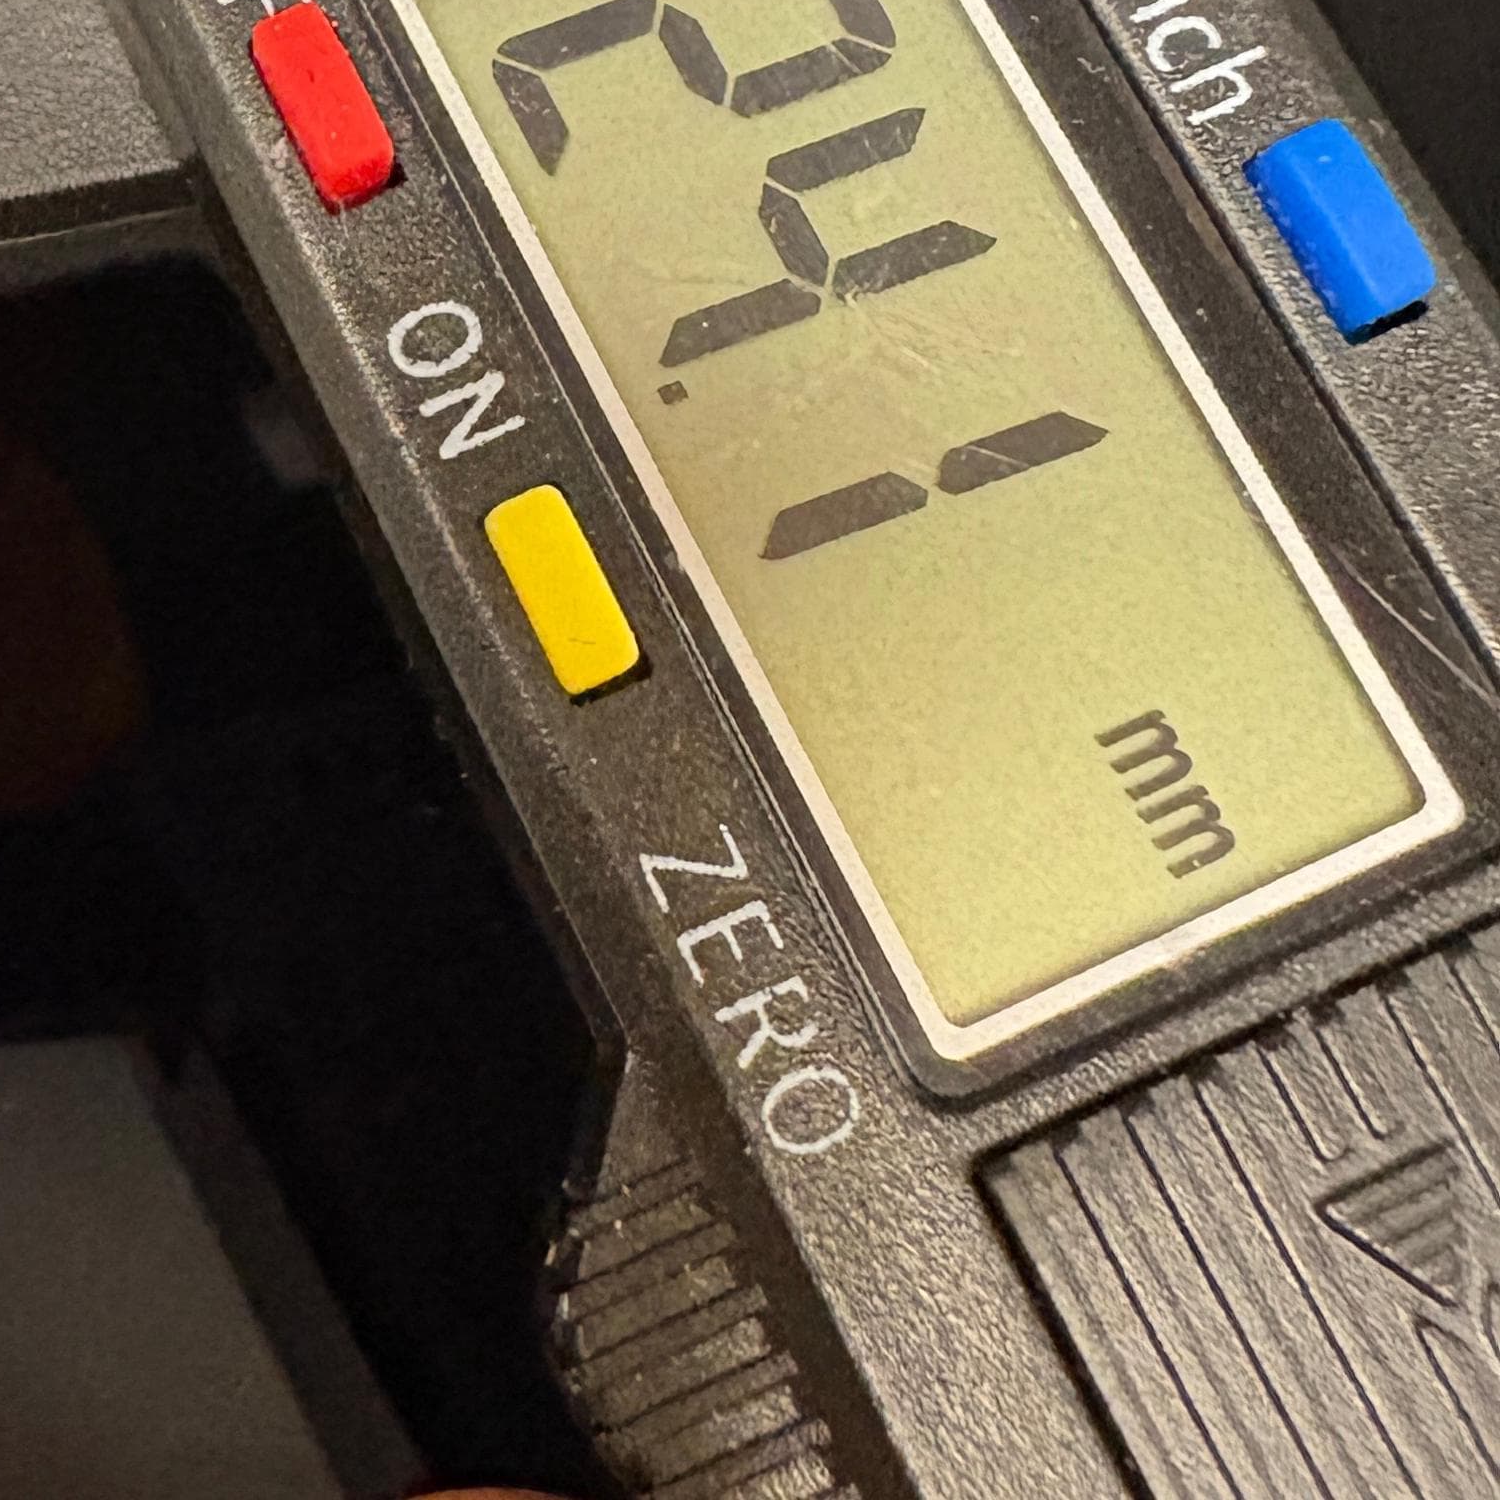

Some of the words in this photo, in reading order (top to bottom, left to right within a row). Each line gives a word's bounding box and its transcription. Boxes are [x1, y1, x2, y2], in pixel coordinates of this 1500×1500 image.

[386, 300, 527, 461] ON
[1094, 707, 1238, 880] mm
[638, 823, 862, 1156] ZERO
